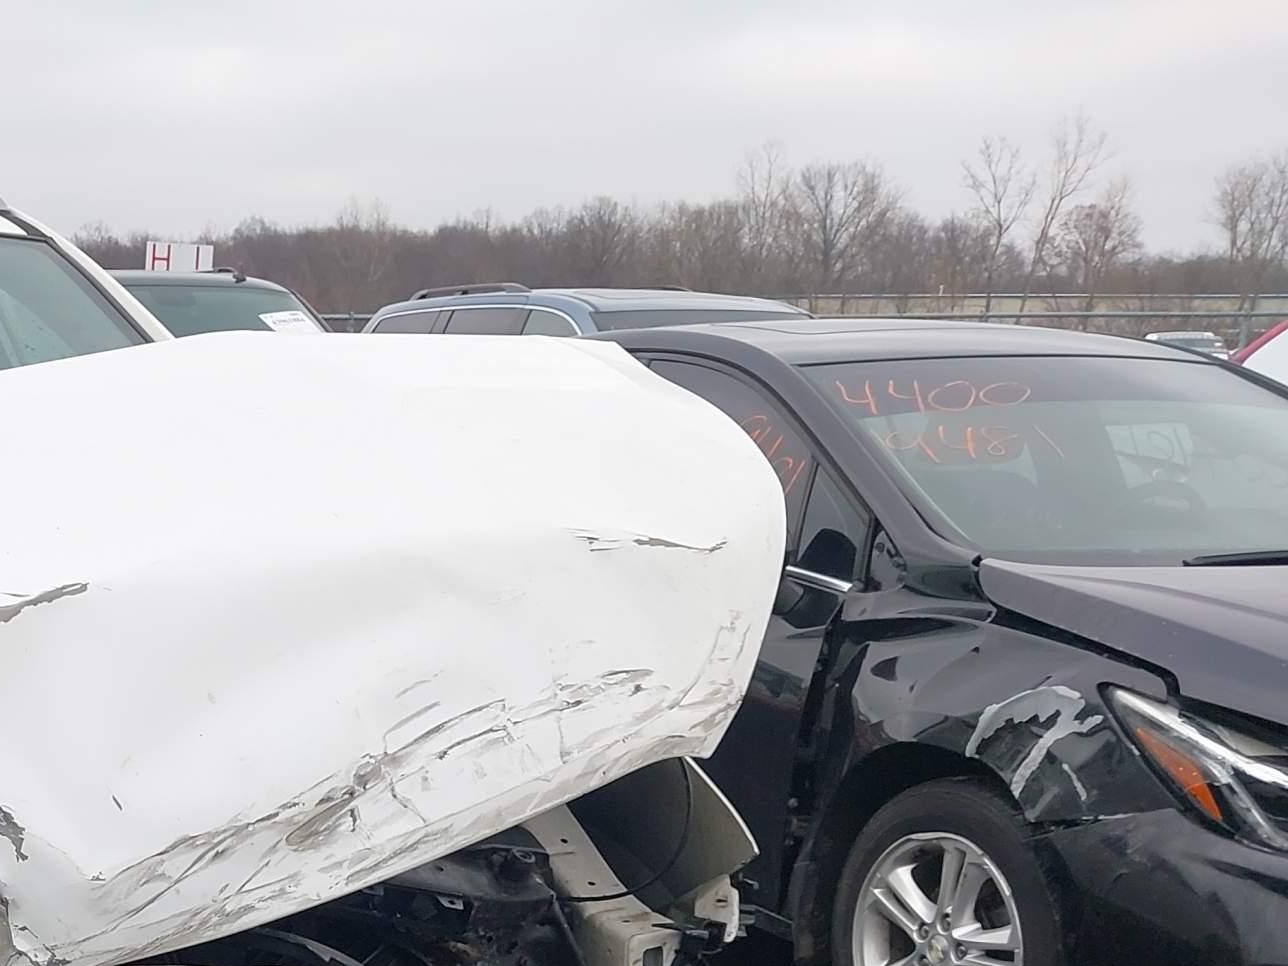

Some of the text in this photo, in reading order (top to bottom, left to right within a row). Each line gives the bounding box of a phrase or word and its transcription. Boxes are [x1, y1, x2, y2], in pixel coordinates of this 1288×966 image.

[152, 243, 171, 271] H
[834, 379, 1032, 415] 4400
[885, 424, 1065, 465] 9481
